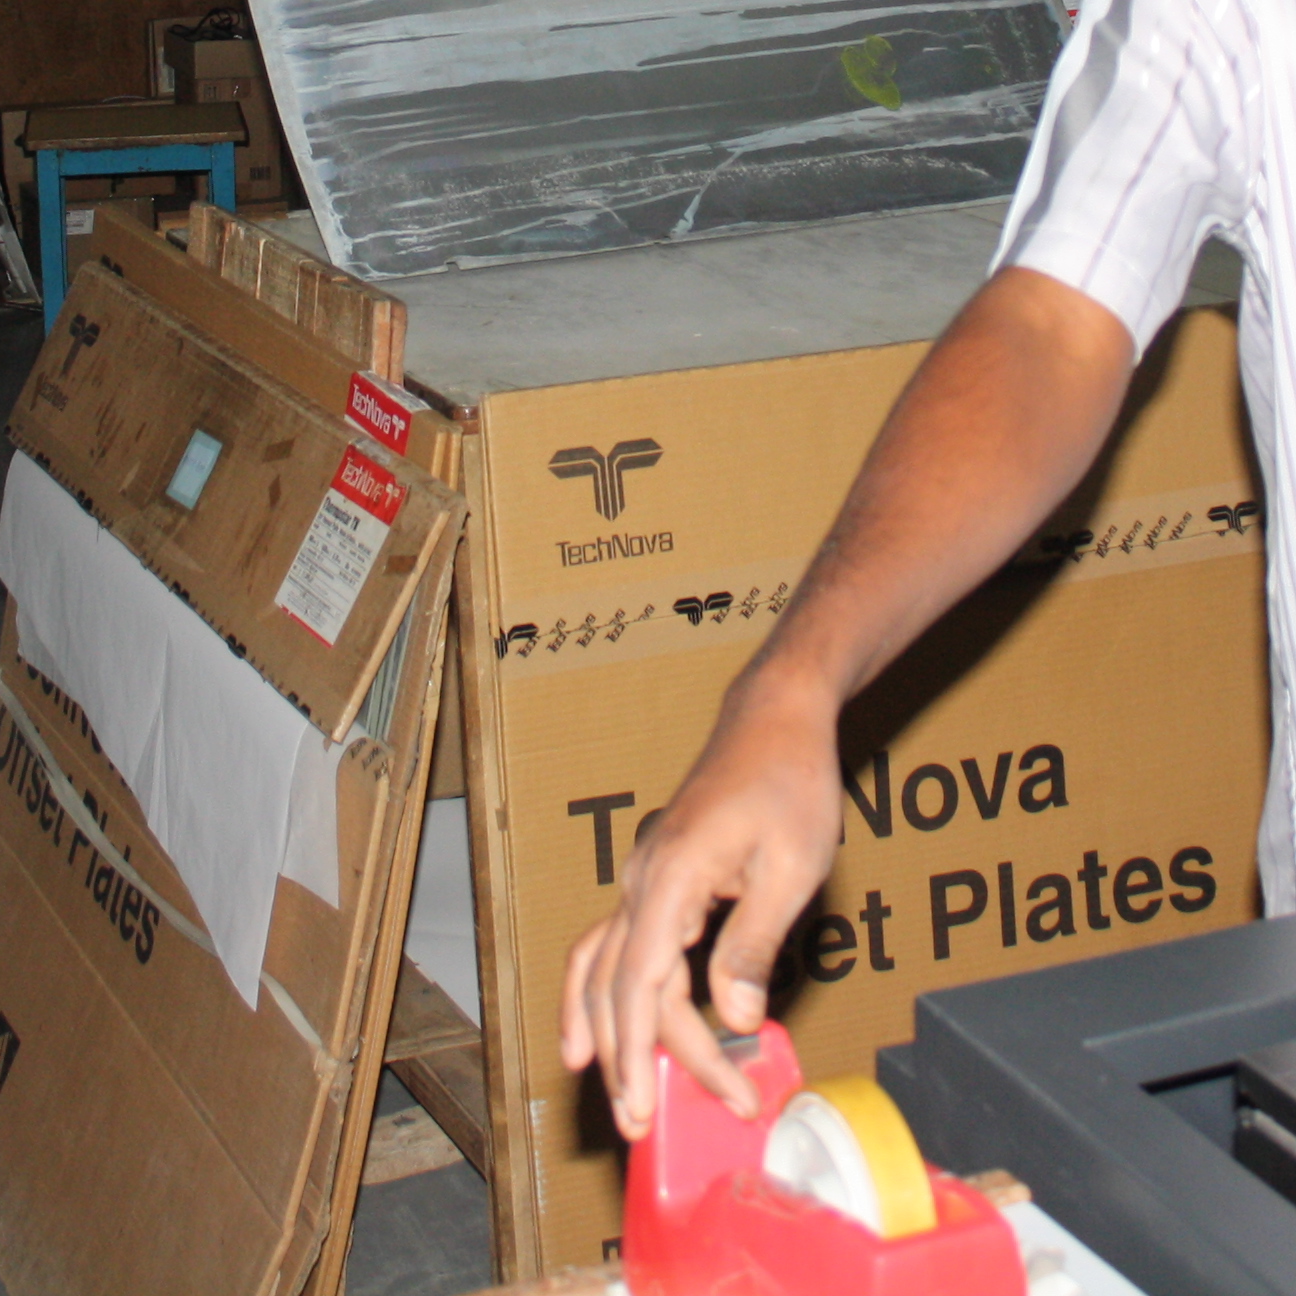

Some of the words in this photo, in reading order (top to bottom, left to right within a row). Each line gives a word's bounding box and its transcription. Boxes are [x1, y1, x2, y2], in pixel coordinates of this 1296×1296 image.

[352, 383, 391, 436] TechNova
[556, 530, 674, 569] TechNova
[567, 743, 1070, 886] TNova
[930, 846, 1217, 961] Plates
